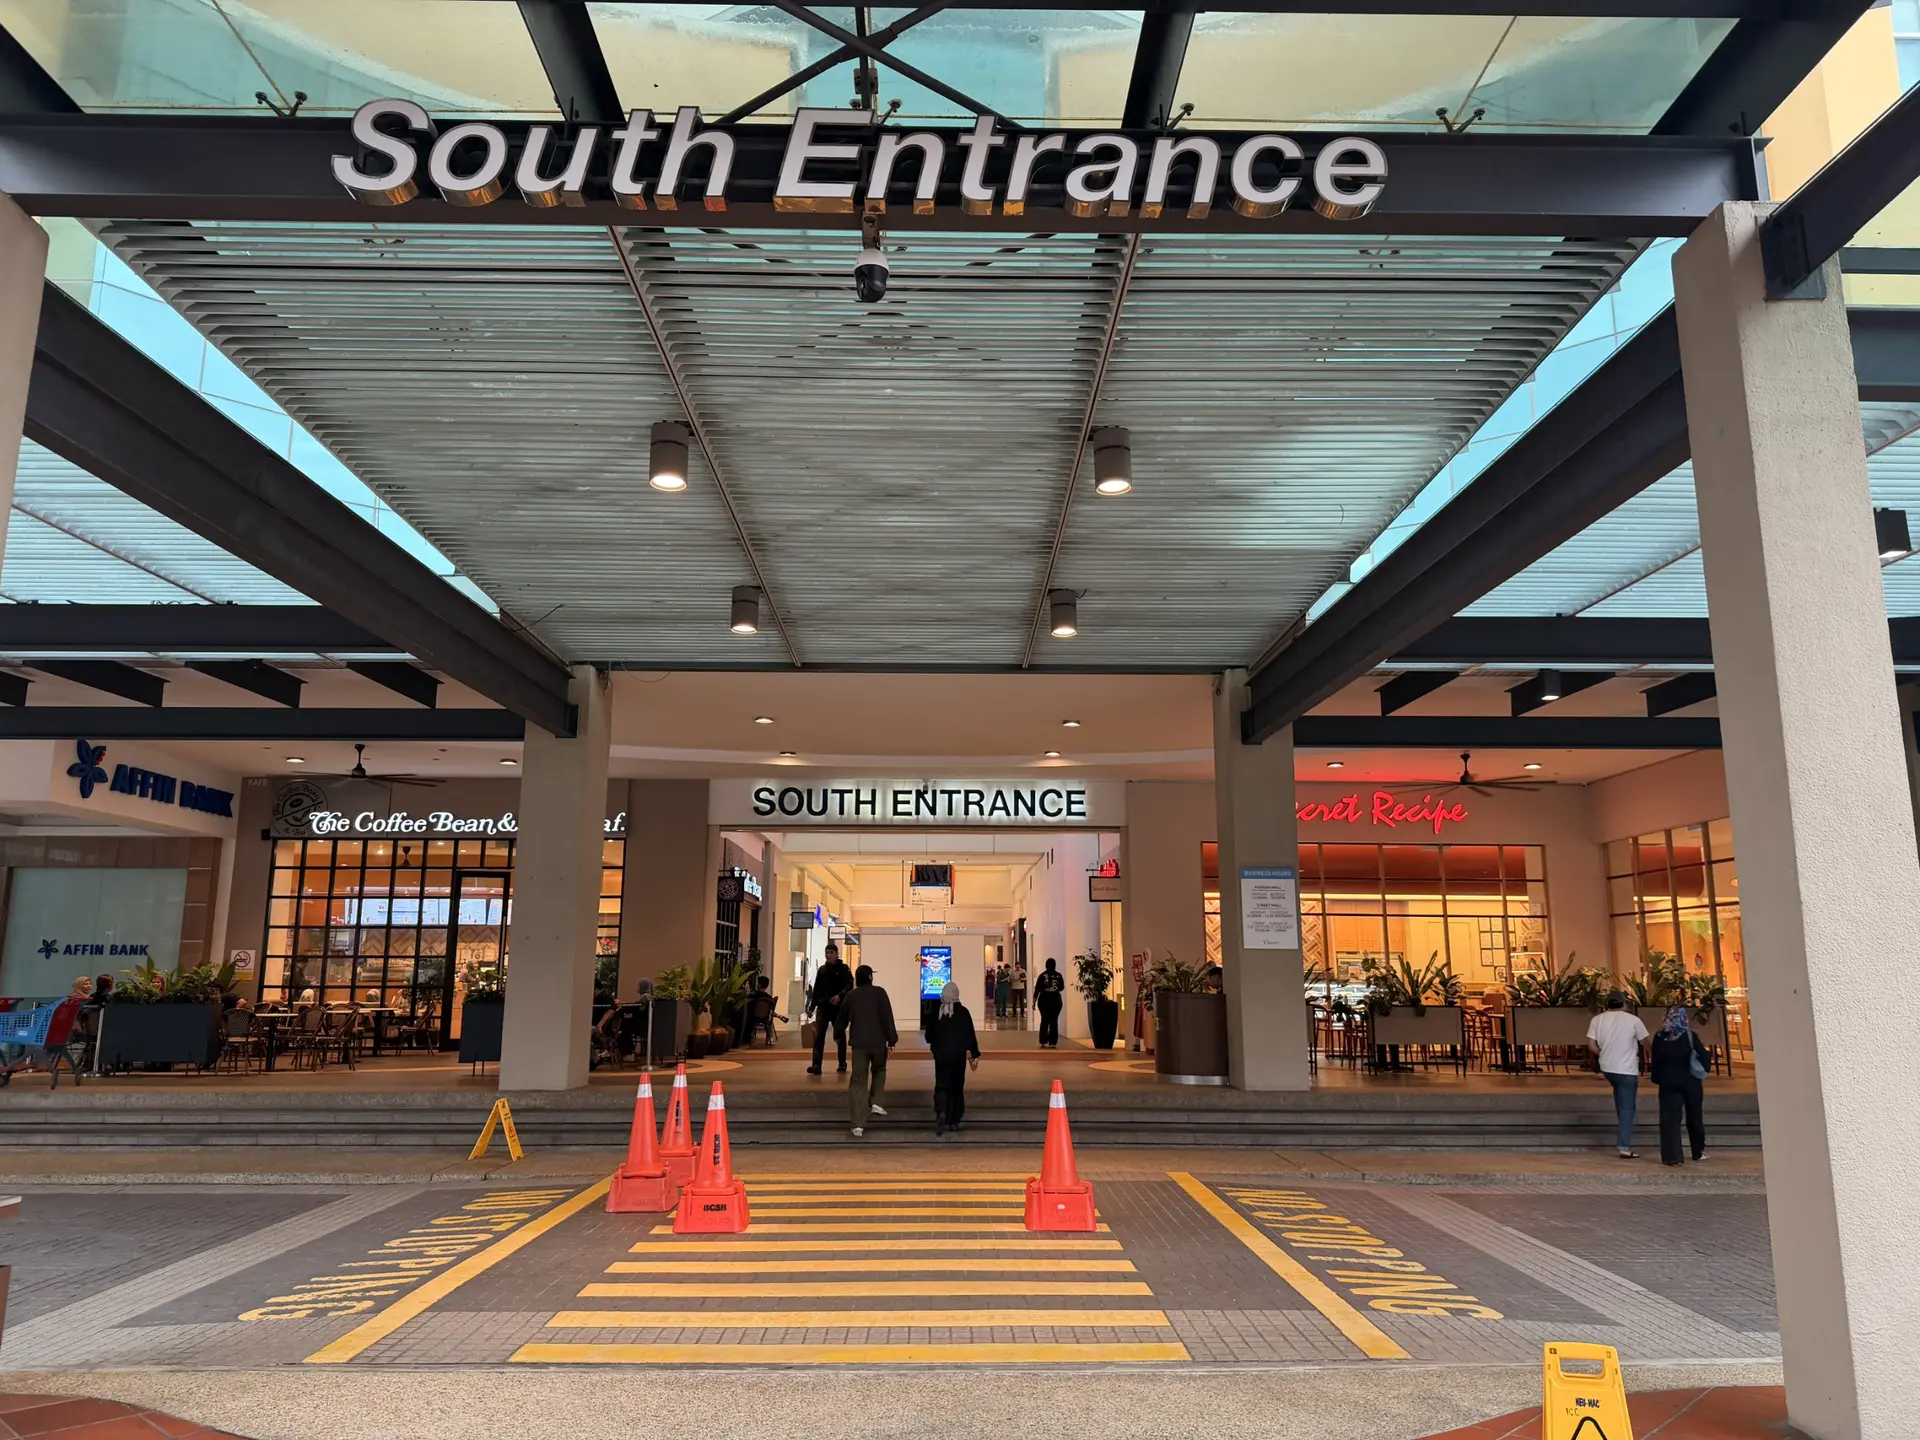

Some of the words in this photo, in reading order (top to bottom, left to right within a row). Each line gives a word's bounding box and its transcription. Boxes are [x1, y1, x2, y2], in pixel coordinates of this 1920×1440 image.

[331, 98, 736, 206] South
[774, 107, 1388, 214] Entrance
[110, 764, 177, 804] AFFIN
[179, 781, 235, 818] BANK
[753, 787, 877, 818] SOUTH
[892, 788, 1087, 819] ENTRANCE
[309, 811, 350, 834] The
[355, 811, 427, 832] Coffee
[603, 811, 626, 832] af.
[1296, 794, 1363, 823] cret
[1371, 792, 1468, 834] Recipe
[63, 944, 104, 956] AFFIN
[109, 944, 149, 956] BANK
[462, 1188, 576, 1211] NO
[1218, 1186, 1328, 1210] NO
[237, 1213, 532, 1322] STOPPING
[1251, 1211, 1505, 1321] STOPPING
